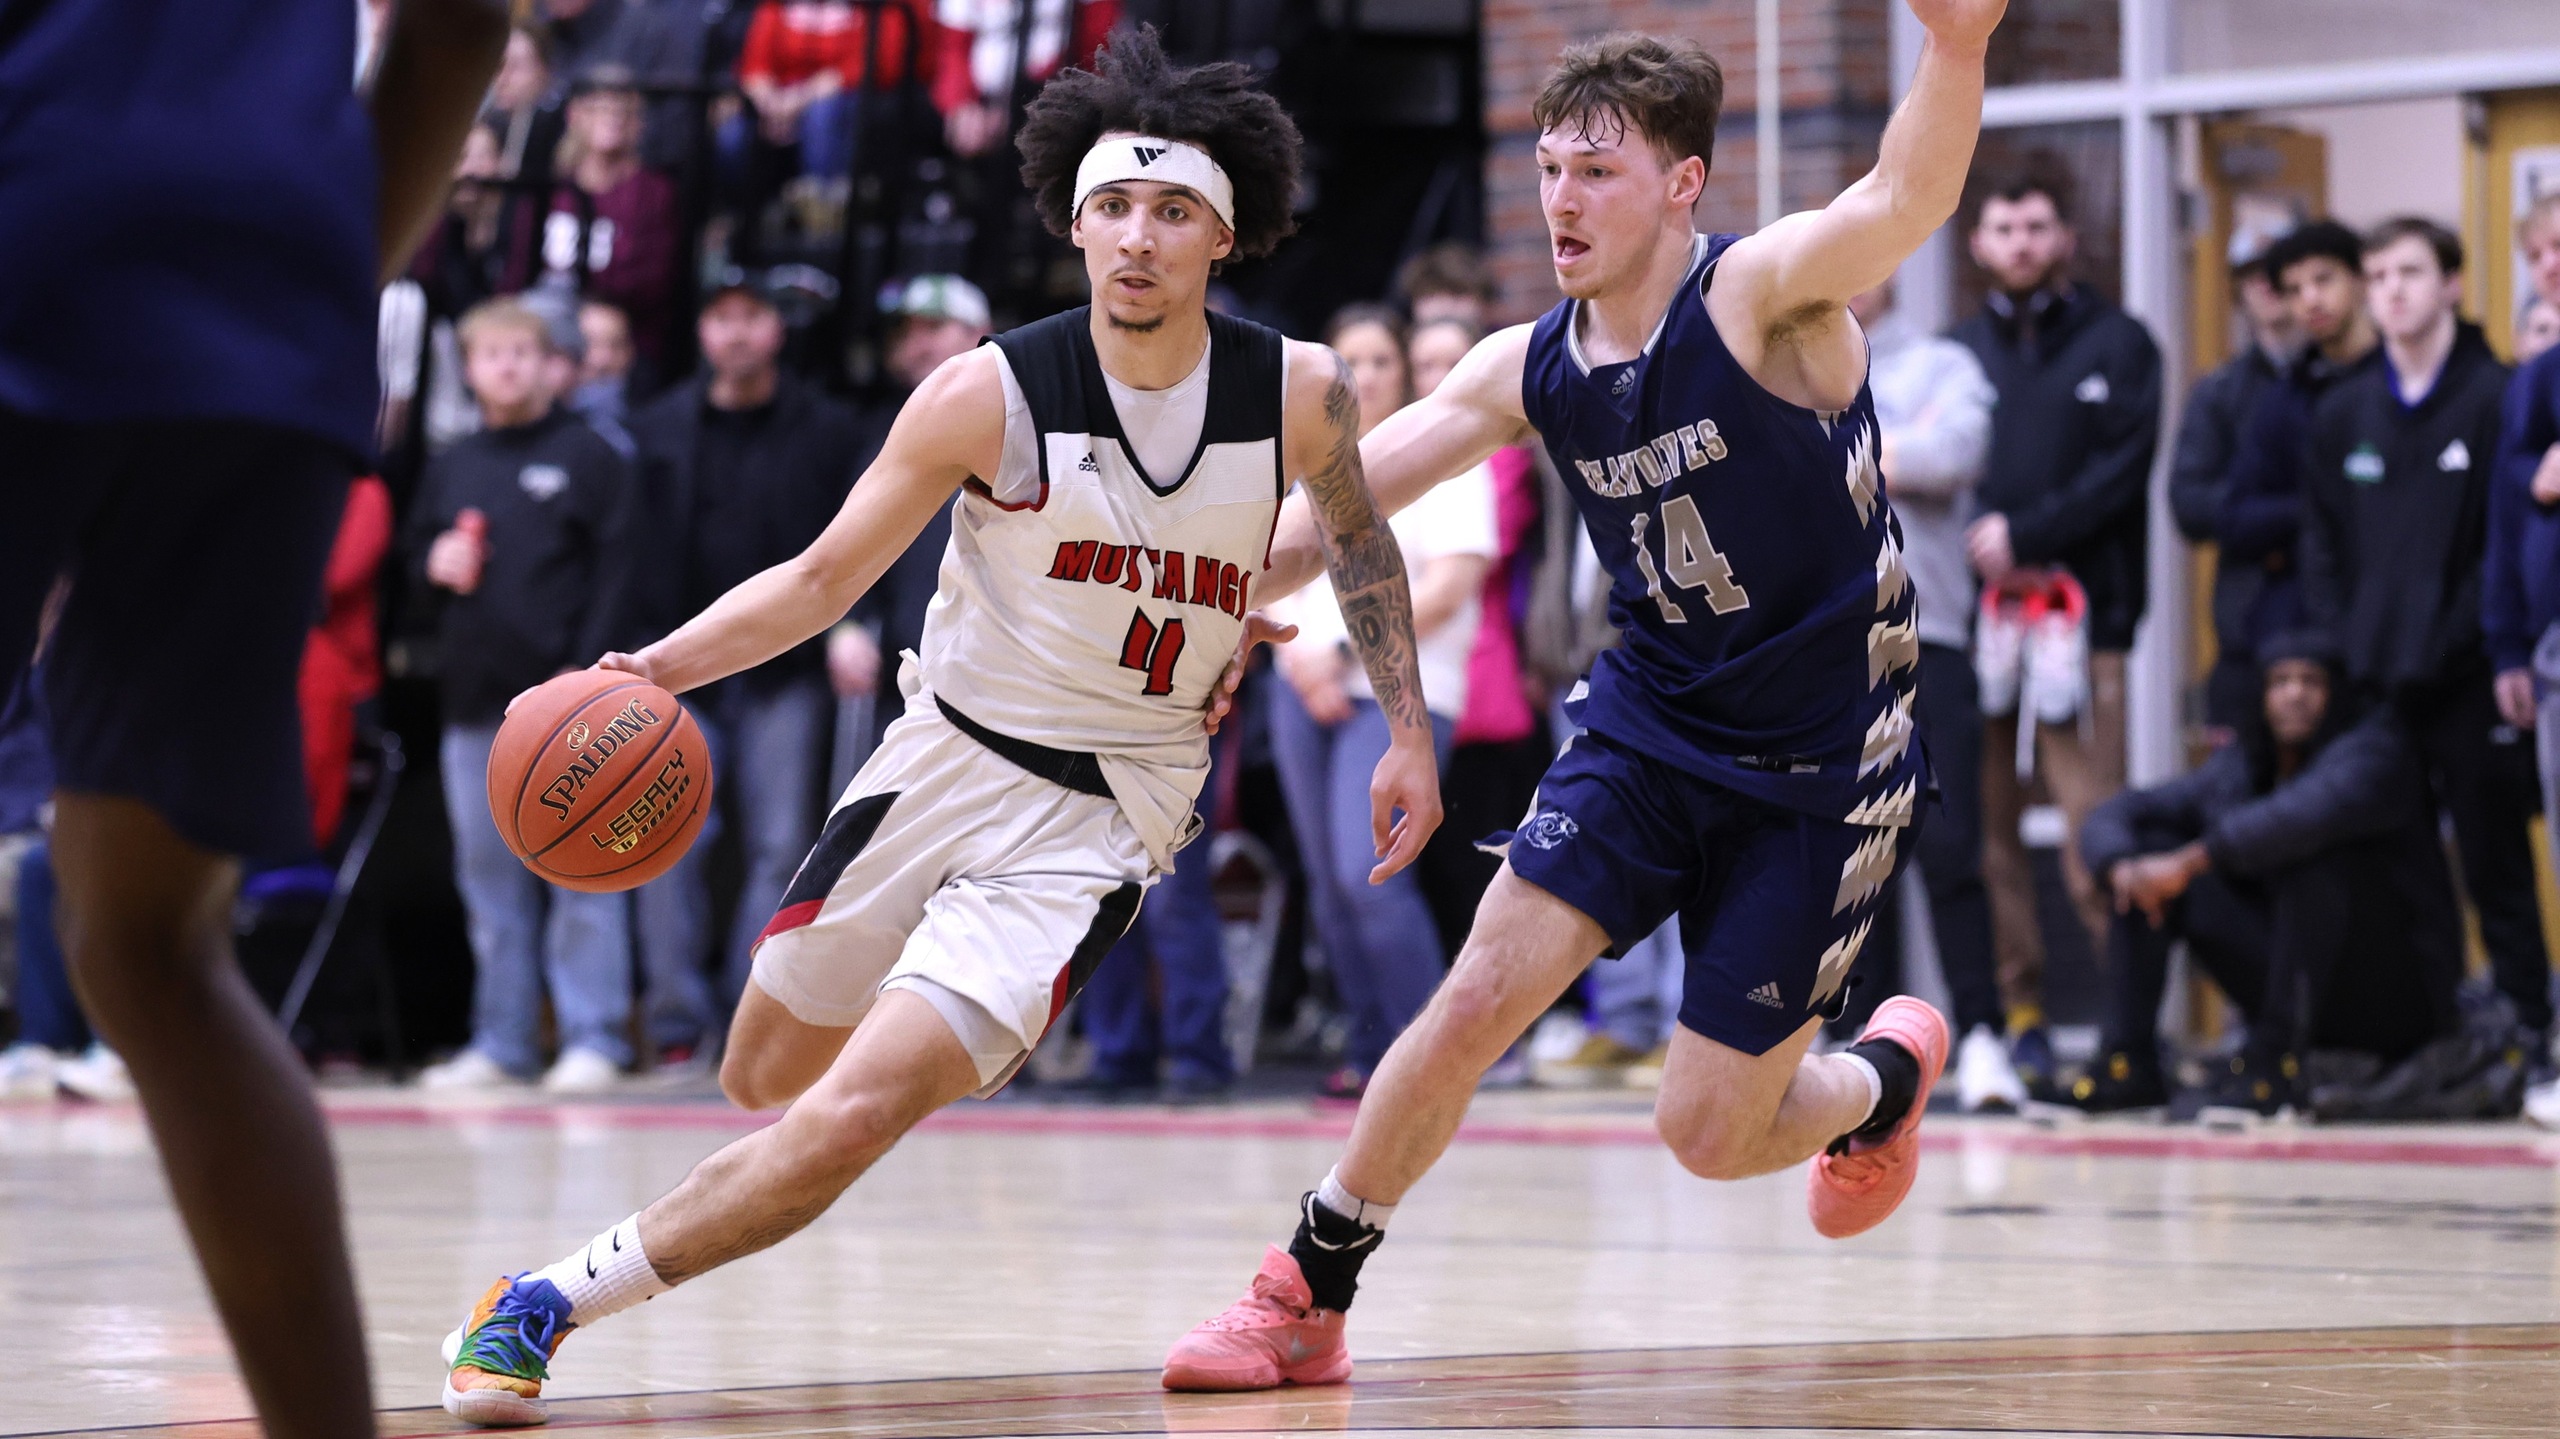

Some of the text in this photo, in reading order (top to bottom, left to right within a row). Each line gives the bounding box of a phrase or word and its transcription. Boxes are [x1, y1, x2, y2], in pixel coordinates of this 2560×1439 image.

[1630, 494, 1750, 624] 14
[1118, 605, 1186, 696] 4
[539, 697, 663, 823] SPALDING
[589, 747, 685, 850] LEGACY
[638, 774, 691, 838] 1000
[1746, 992, 1785, 1010] adidas
